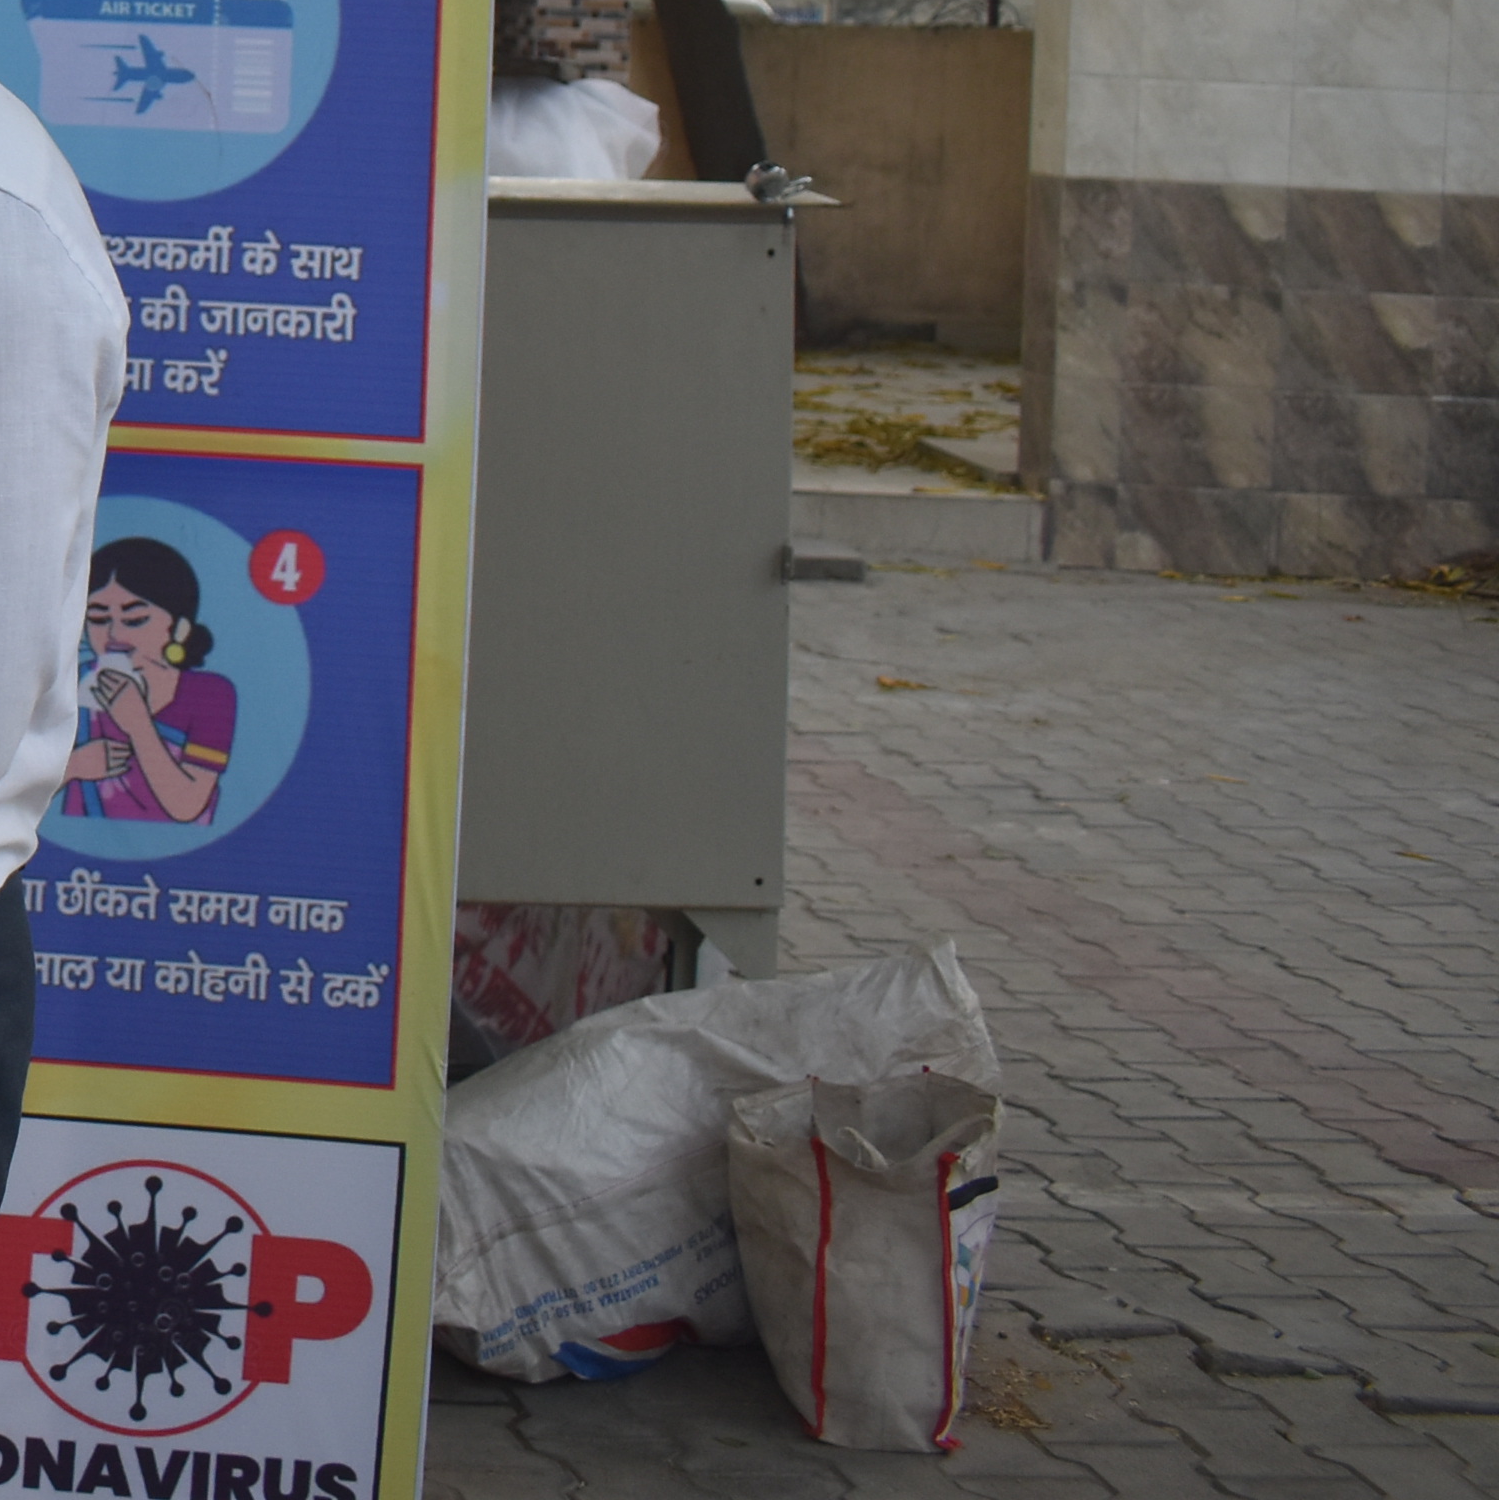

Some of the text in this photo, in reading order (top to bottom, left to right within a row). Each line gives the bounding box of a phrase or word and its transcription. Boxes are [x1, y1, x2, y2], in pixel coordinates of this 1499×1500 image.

[99, 0, 197, 19] AIR TICKET
[241, 231, 281, 278] के
[290, 242, 364, 281] साथ
[140, 284, 357, 343] की जानकारी
[163, 350, 229, 396] करें
[270, 541, 302, 592] 4
[55, 866, 158, 923] छींकते
[169, 887, 259, 927] समय
[268, 895, 349, 934] नाक
[105, 957, 146, 994] या
[154, 949, 269, 1004] कोहनी
[279, 959, 314, 1005] से
[322, 963, 392, 1010] ढकें
